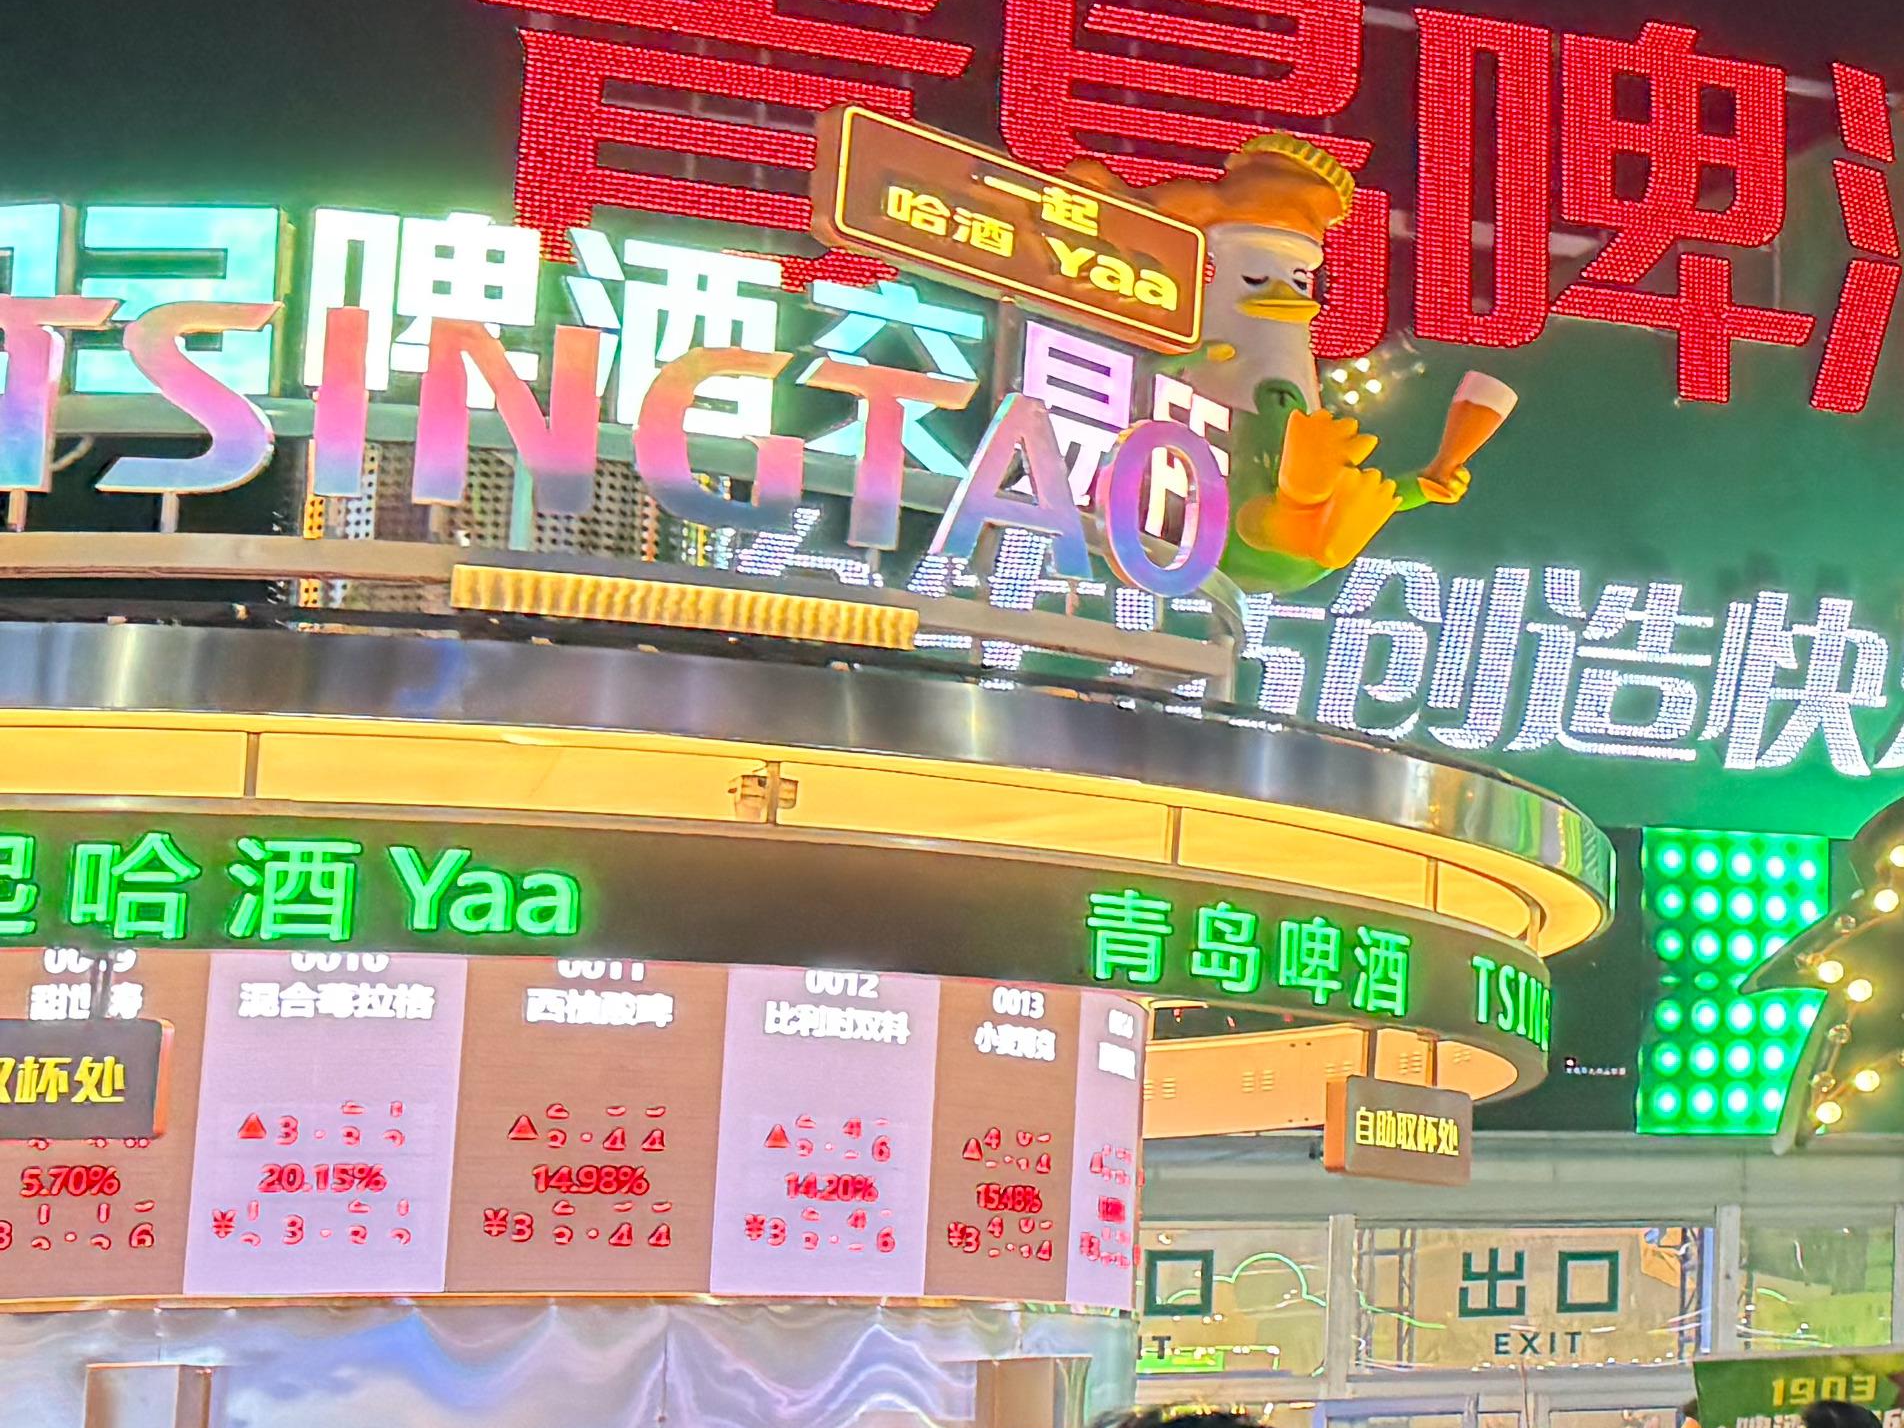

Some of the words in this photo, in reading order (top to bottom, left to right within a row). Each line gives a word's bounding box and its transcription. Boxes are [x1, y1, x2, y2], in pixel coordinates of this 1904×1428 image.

[980, 174, 1099, 237] 一起
[886, 185, 1016, 258] 哈酒
[1044, 233, 1179, 312] Yaa
[0, 294, 1231, 597] TSINGTAO
[0, 832, 364, 941] 哈酒
[388, 846, 583, 936] Yaa
[1086, 888, 1413, 1018] 青岛啤酒
[805, 969, 880, 999] 0012
[992, 986, 1046, 1019] 0013
[0, 1055, 126, 1104] 杯处
[1355, 1106, 1460, 1156] 自助取杯处
[256, 1163, 388, 1194] 20.15%
[532, 1164, 650, 1196] 14.98%
[784, 1171, 880, 1203] 14.20%
[1458, 1246, 1620, 1318] 出口
[1493, 1330, 1584, 1356] EXIT
[1771, 1373, 1877, 1407] 1903
